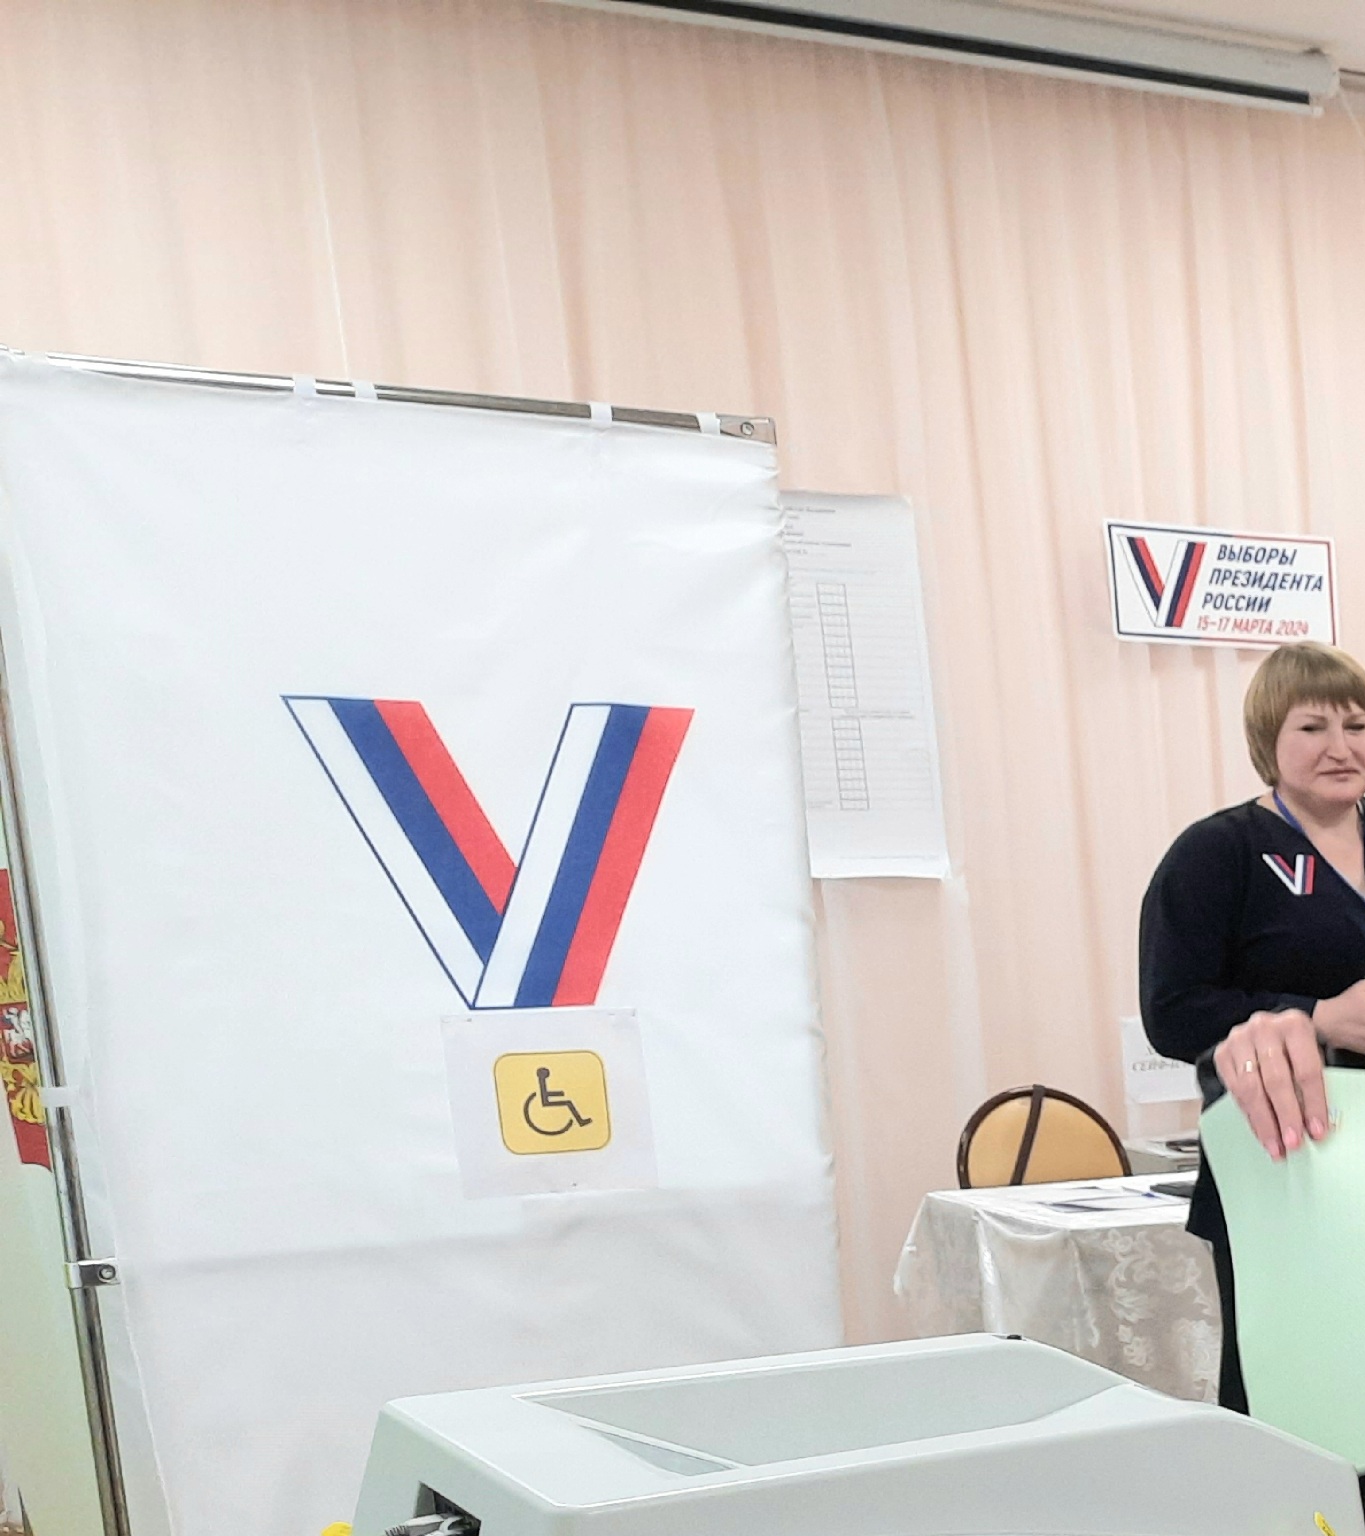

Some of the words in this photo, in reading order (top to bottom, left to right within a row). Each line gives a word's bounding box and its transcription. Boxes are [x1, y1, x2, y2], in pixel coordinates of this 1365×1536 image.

[1217, 544, 1298, 566] ВЫБОРЫ
[1209, 568, 1324, 592] ПРЕЗИДЕНТА
[1202, 592, 1273, 613] РОССИИ
[1232, 618, 1274, 635] МАРТА
[1275, 619, 1310, 636] 2024
